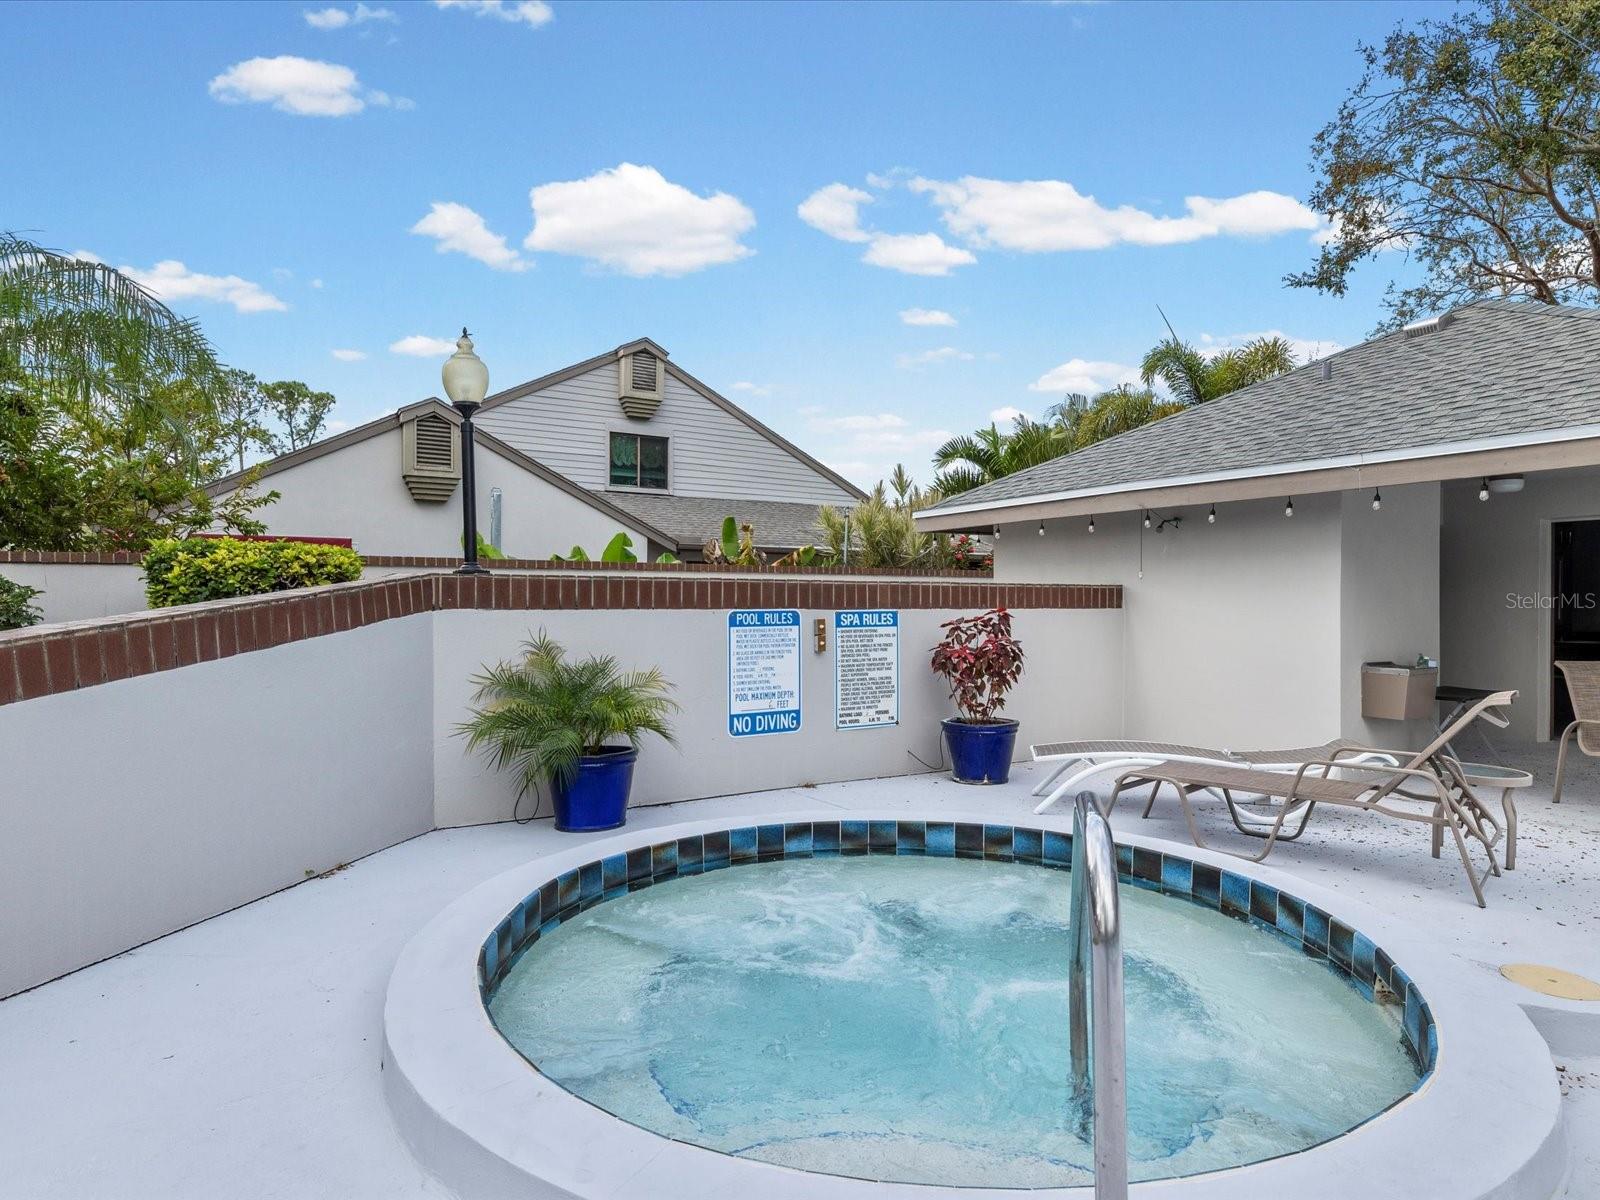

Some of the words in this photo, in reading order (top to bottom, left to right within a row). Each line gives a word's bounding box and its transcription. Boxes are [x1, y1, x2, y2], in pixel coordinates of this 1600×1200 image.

[736, 613, 761, 625] POOL
[764, 612, 793, 624] RULES
[841, 613, 860, 626] SPA
[863, 613, 893, 625] RULES
[735, 693, 749, 702] POOL
[751, 691, 776, 700] MAXIMUM
[777, 700, 789, 708] FEET
[733, 716, 751, 733] NO
[756, 712, 797, 731] DIVING
